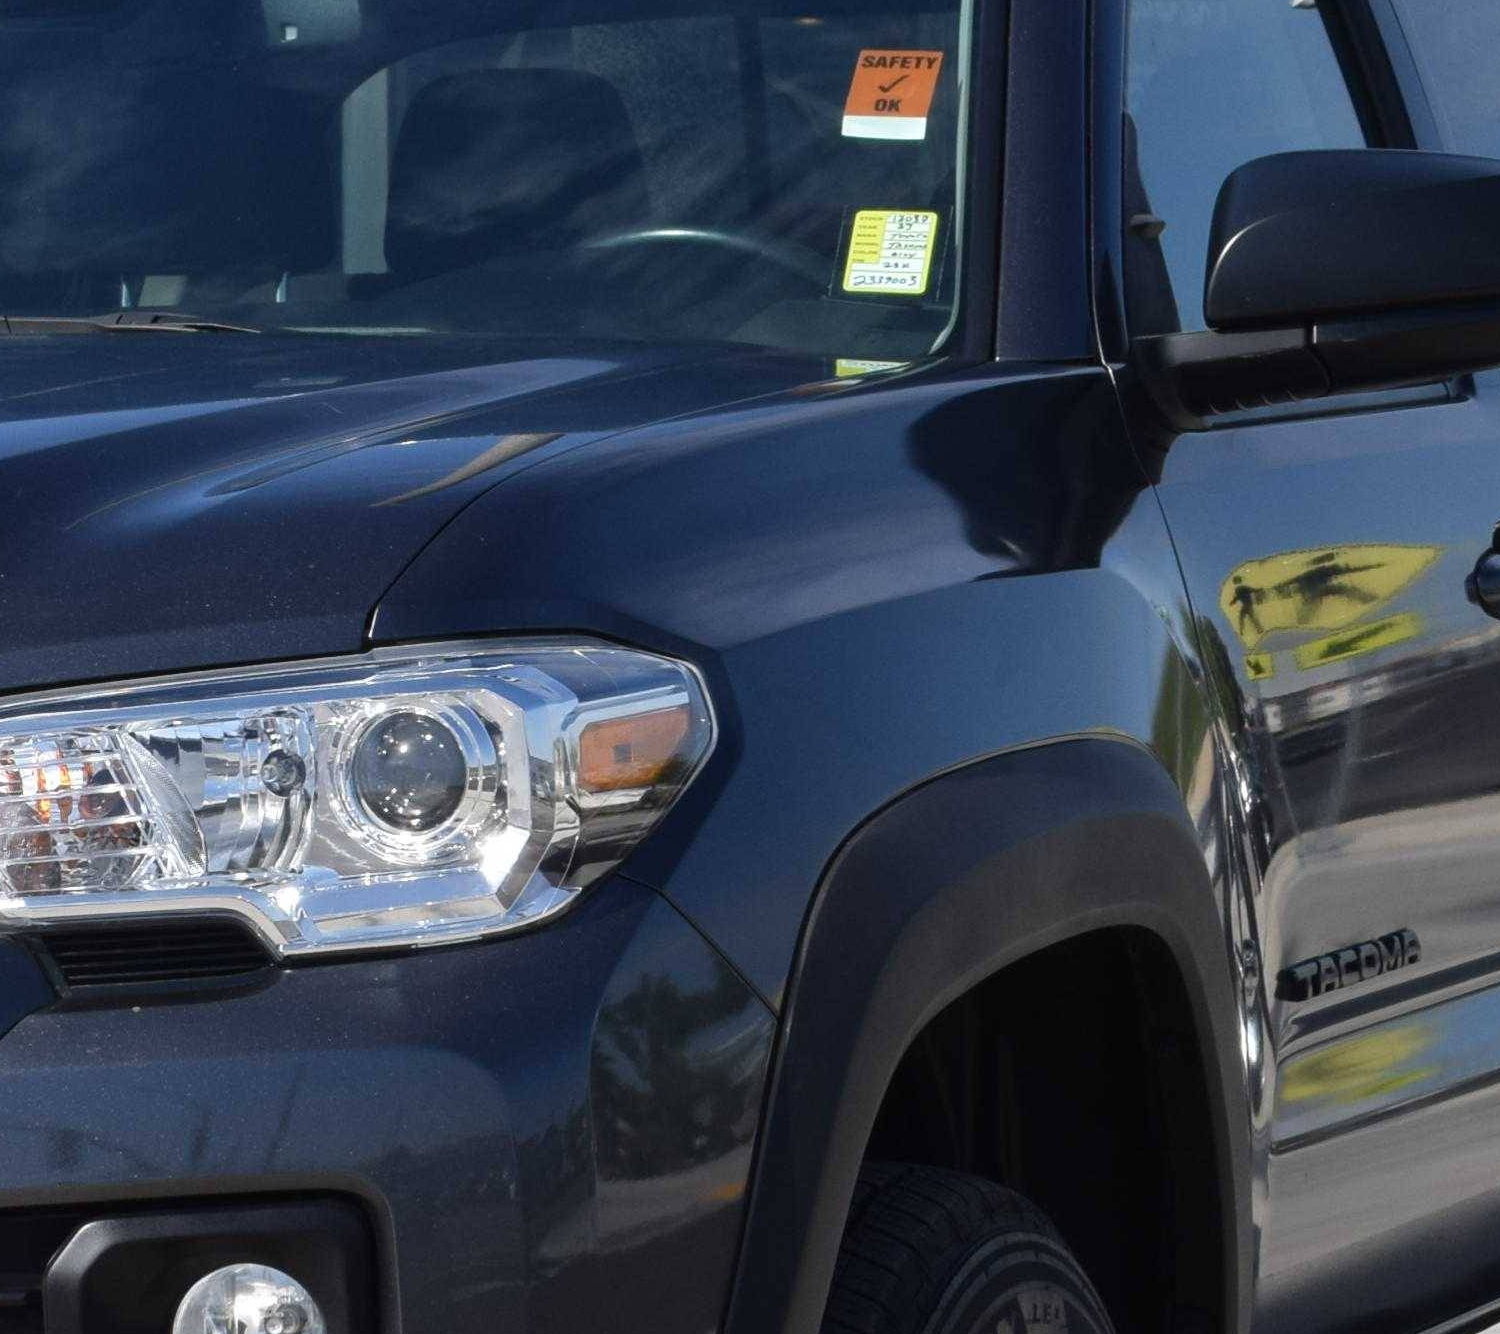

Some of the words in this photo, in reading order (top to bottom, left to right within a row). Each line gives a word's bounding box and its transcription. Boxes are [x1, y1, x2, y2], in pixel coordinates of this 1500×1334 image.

[861, 54, 938, 69] SAFETY
[873, 98, 902, 112] OK
[1292, 929, 1422, 999] TACOMA
